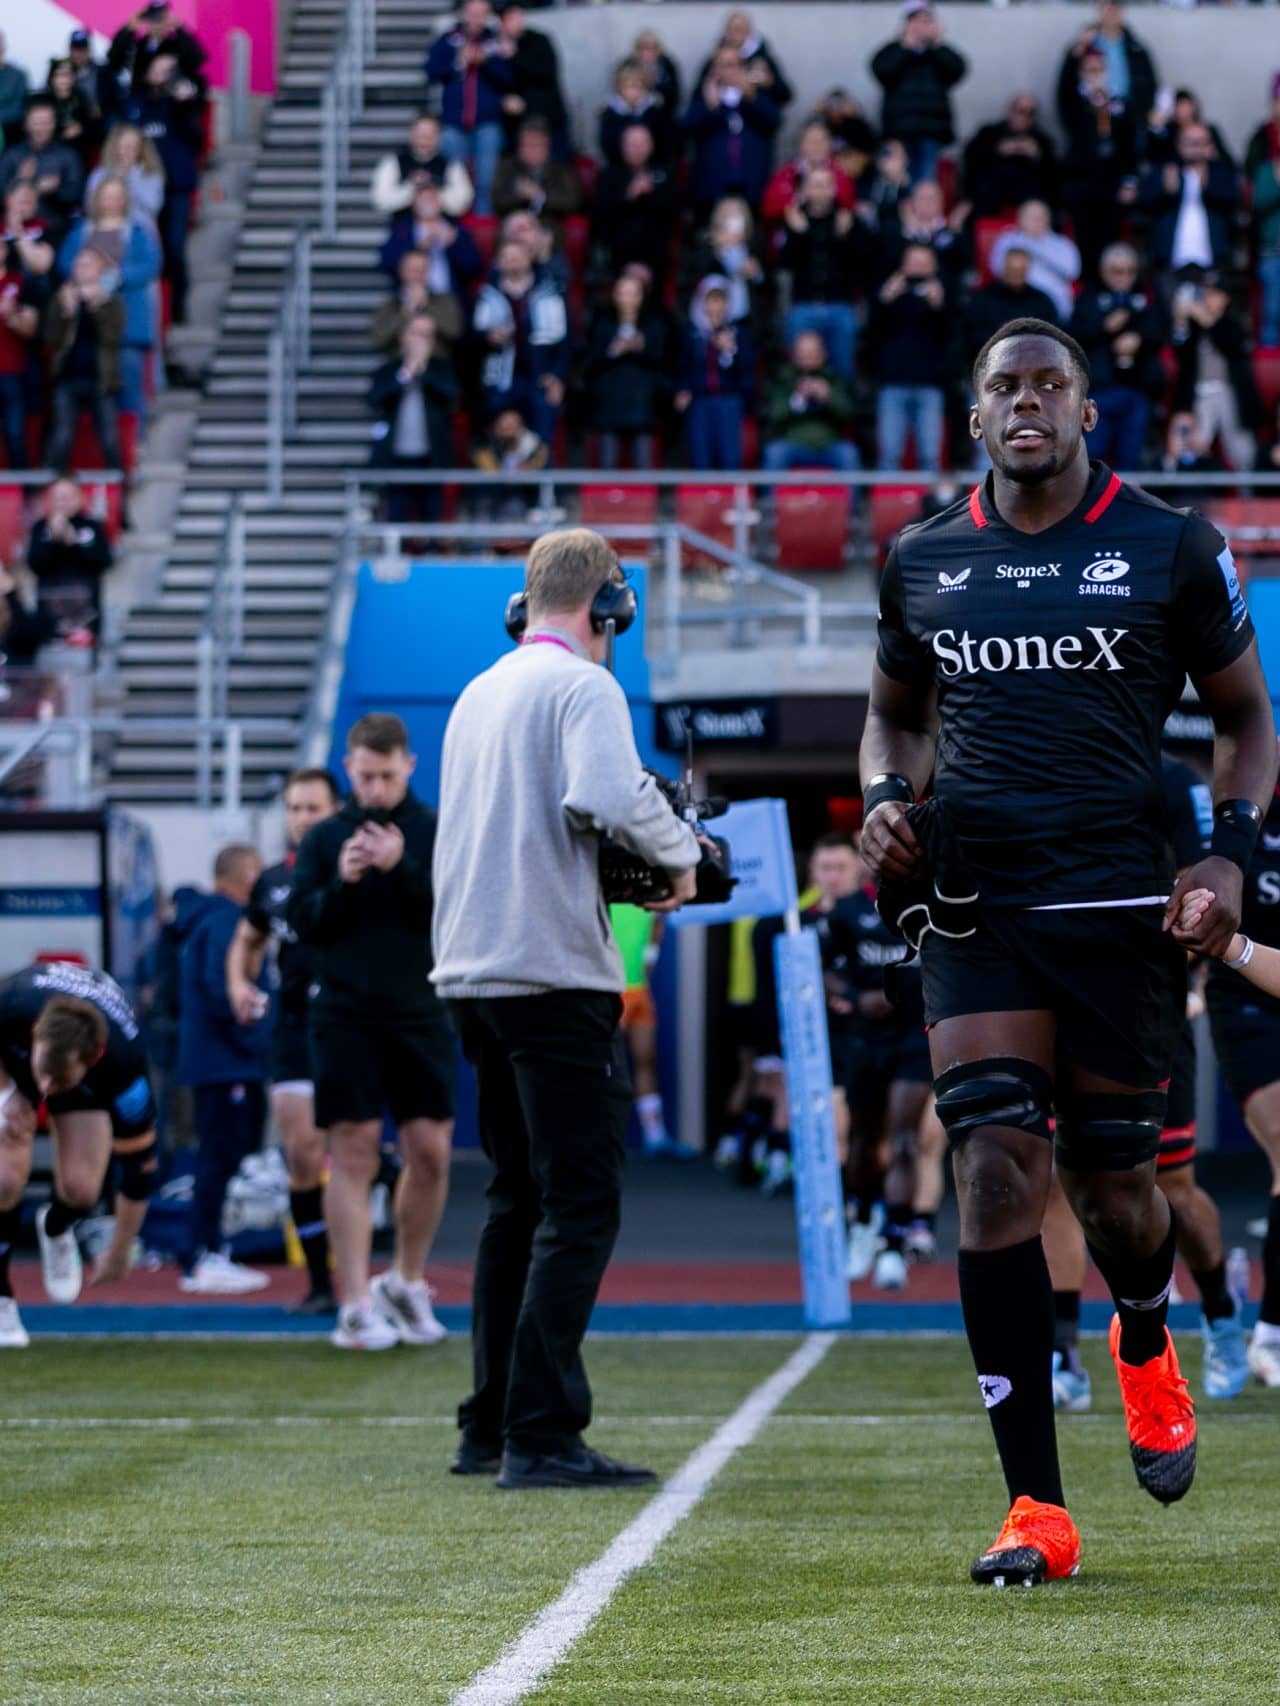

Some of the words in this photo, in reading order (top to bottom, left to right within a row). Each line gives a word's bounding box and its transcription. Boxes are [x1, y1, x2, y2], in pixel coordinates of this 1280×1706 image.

[995, 563, 1062, 579] StoneX
[1078, 584, 1131, 597] SARACENS
[932, 626, 1129, 676] StoneX
